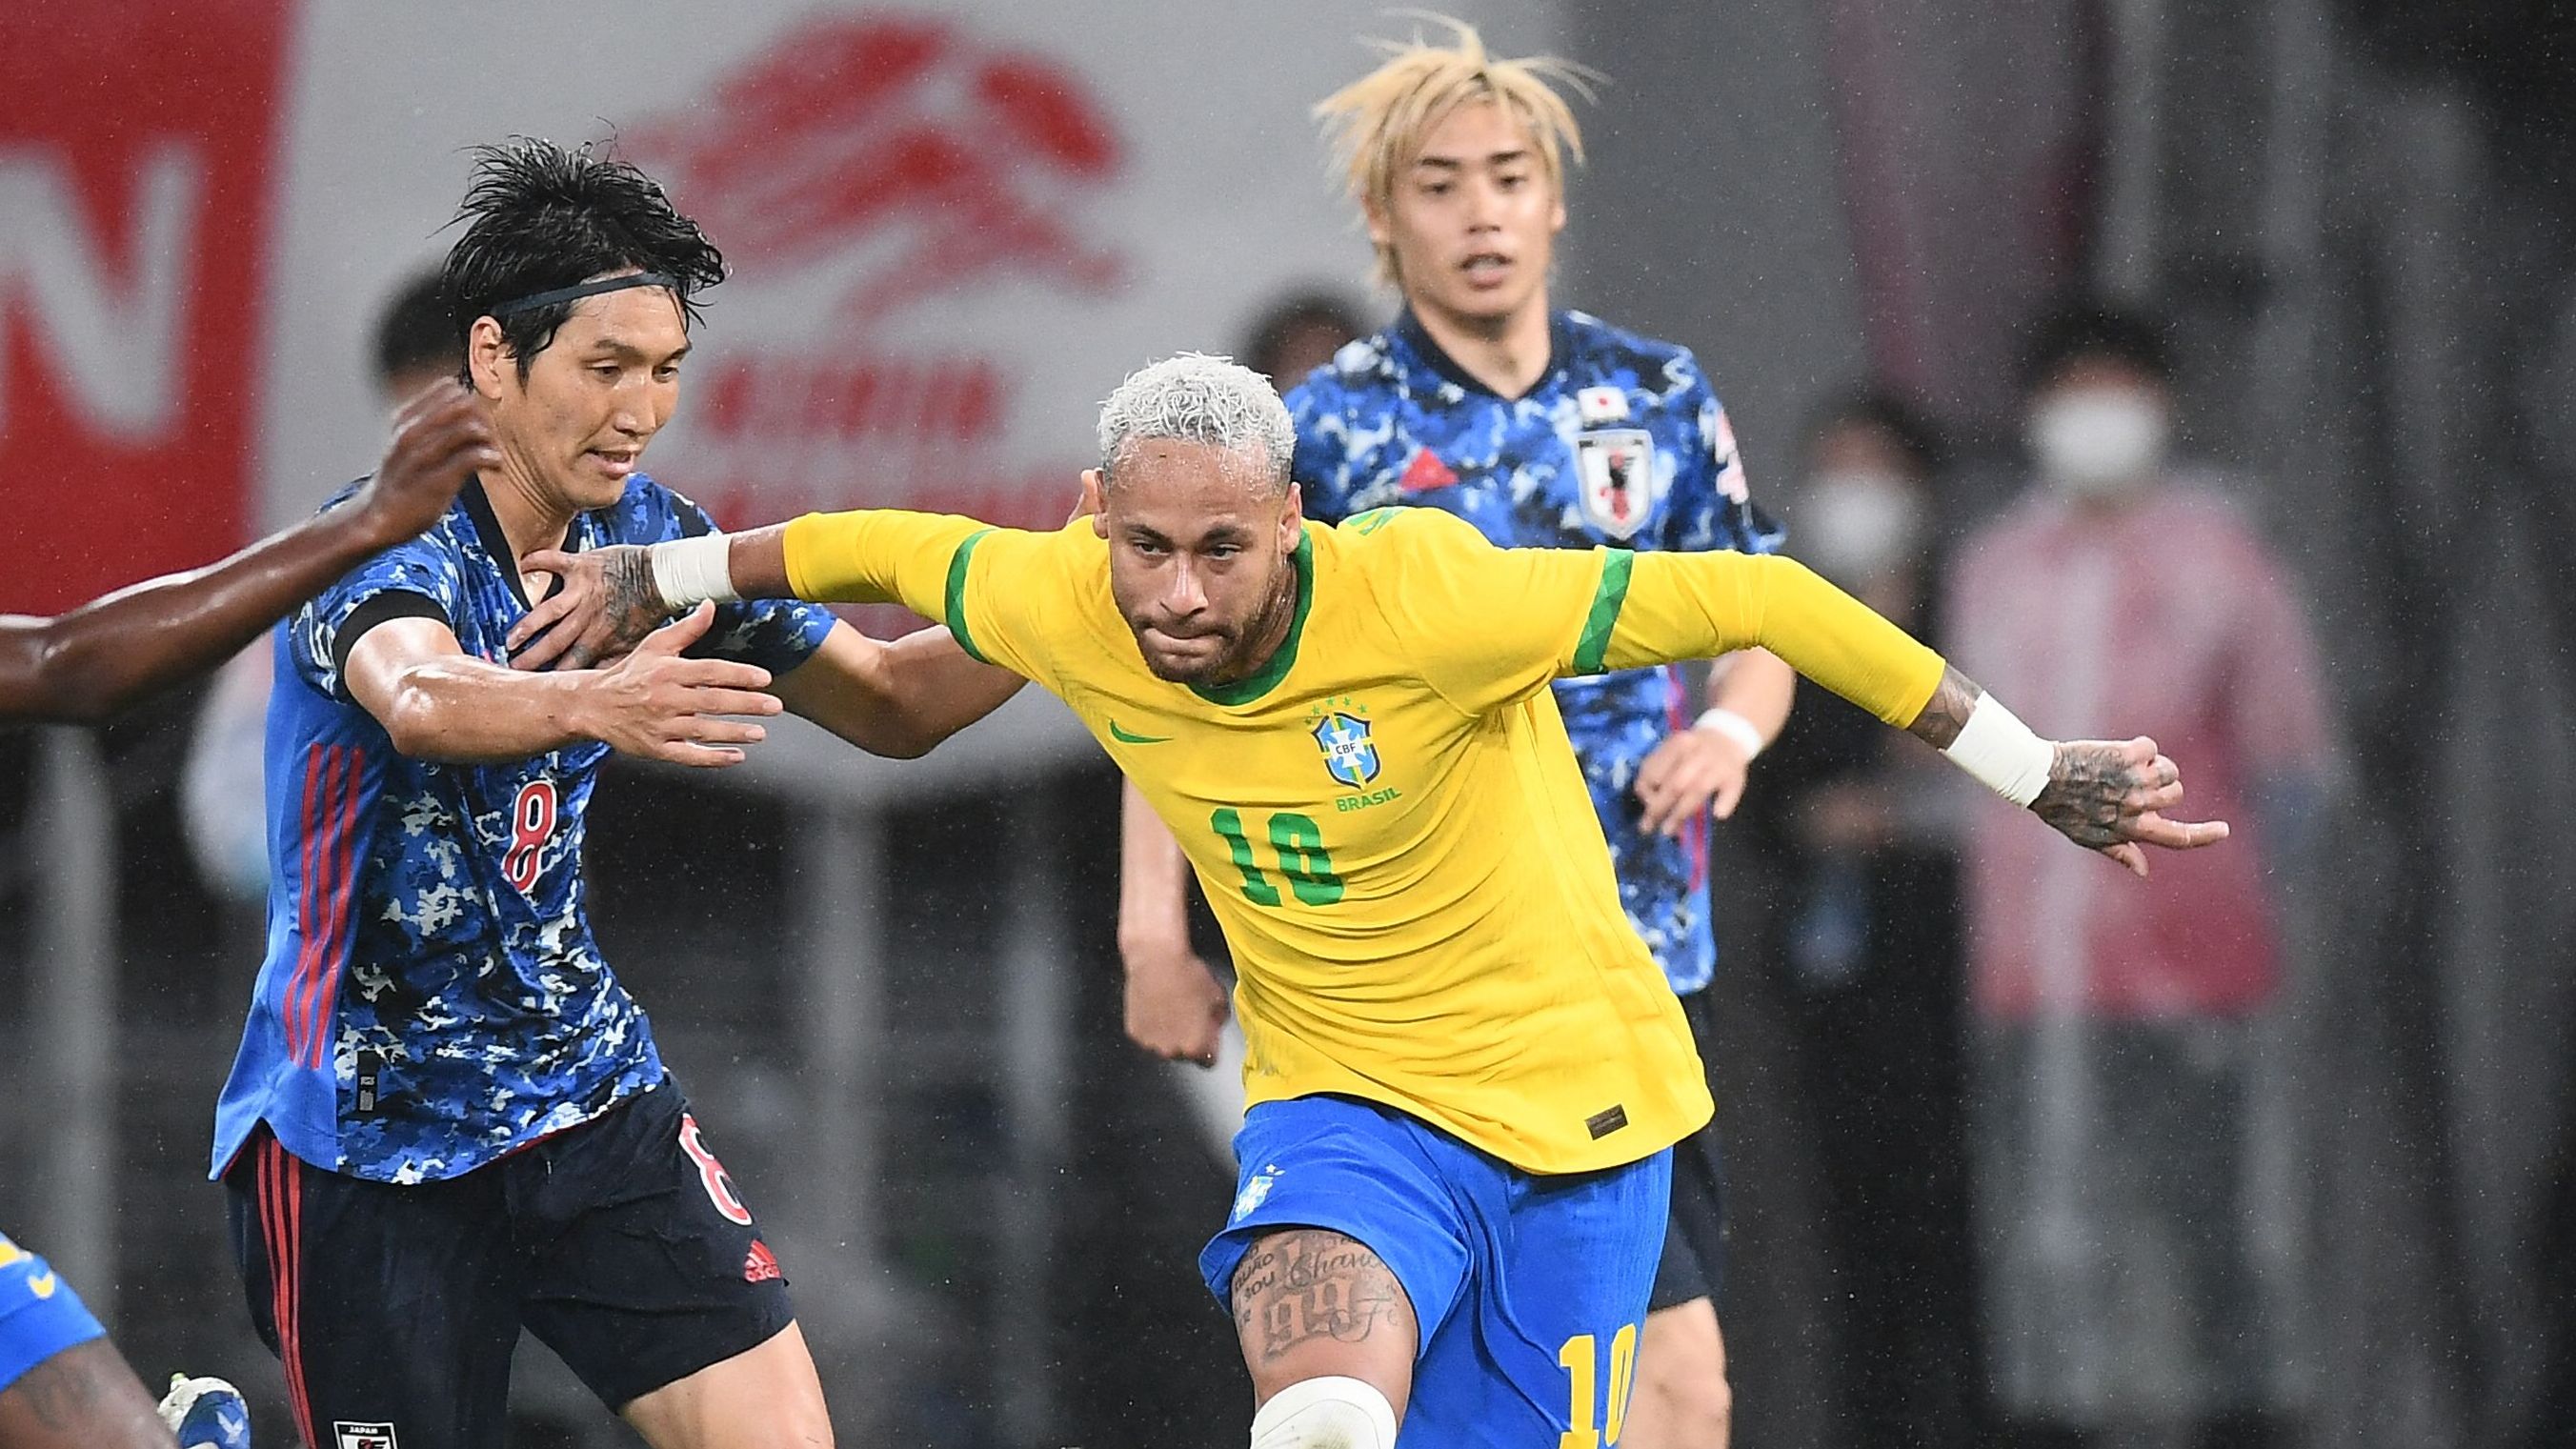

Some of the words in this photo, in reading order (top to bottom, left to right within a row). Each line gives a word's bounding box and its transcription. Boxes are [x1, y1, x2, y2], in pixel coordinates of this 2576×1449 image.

[1335, 743, 1357, 755] CBF
[500, 780, 557, 895] 8
[1336, 787, 1402, 812] BRASIL
[1210, 807, 1345, 907] 10
[1559, 1323, 1637, 1449] 10
